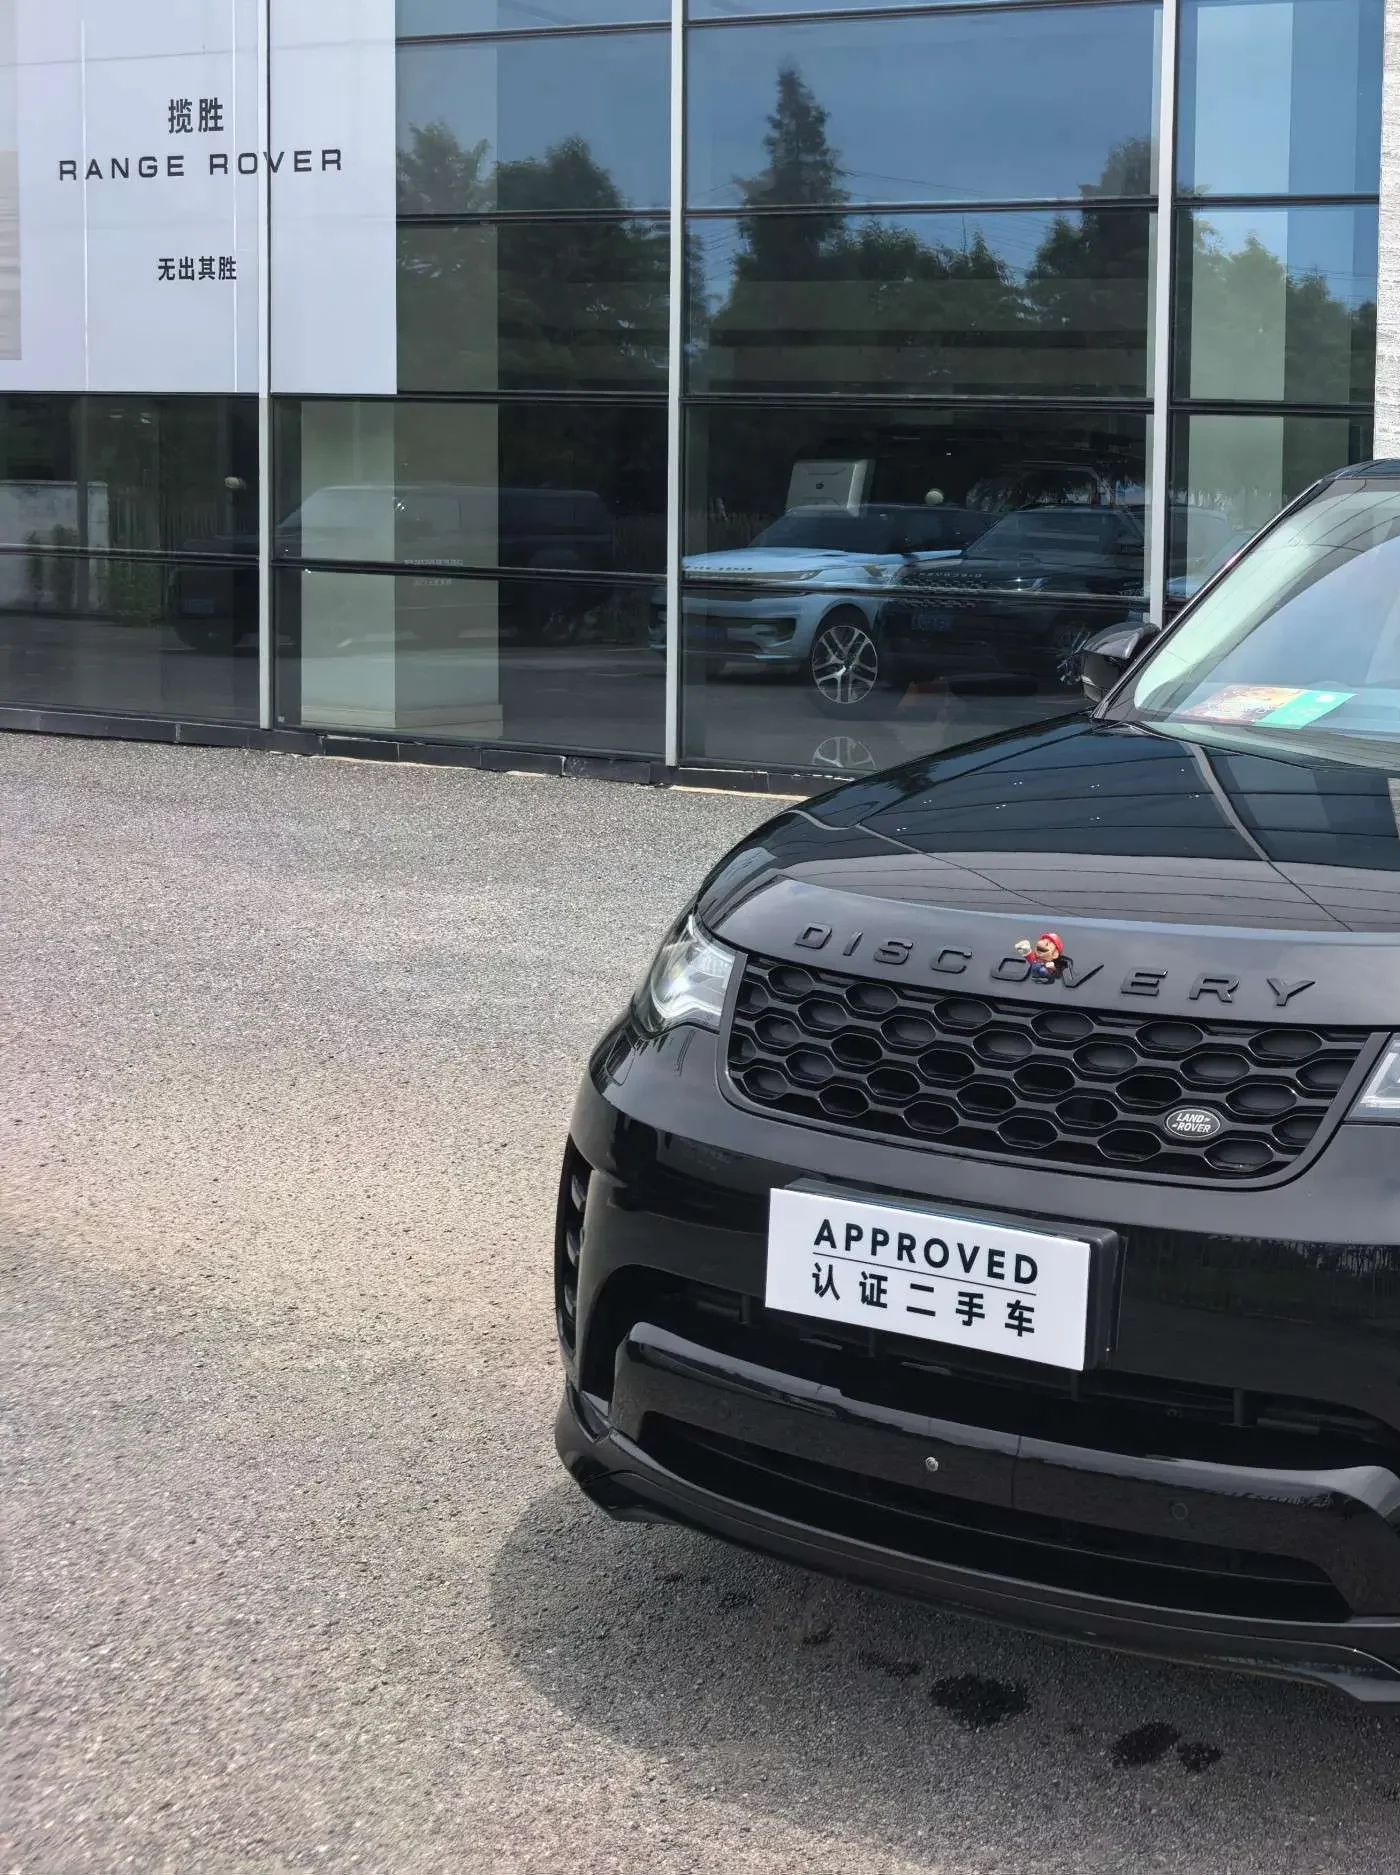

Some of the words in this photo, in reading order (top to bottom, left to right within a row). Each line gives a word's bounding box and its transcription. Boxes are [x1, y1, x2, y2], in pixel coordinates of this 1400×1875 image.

[168, 97, 224, 134] 揽胜
[59, 155, 185, 181] RANGE
[209, 148, 343, 176] ROVER
[157, 255, 237, 281] 无出其胜
[794, 921, 1316, 1008] DISCOVERY
[1176, 1113, 1205, 1123] LAND
[1177, 1122, 1211, 1133] ROVER
[813, 1218, 1040, 1286] APPROVED
[811, 1262, 1037, 1338] 认证二手车
